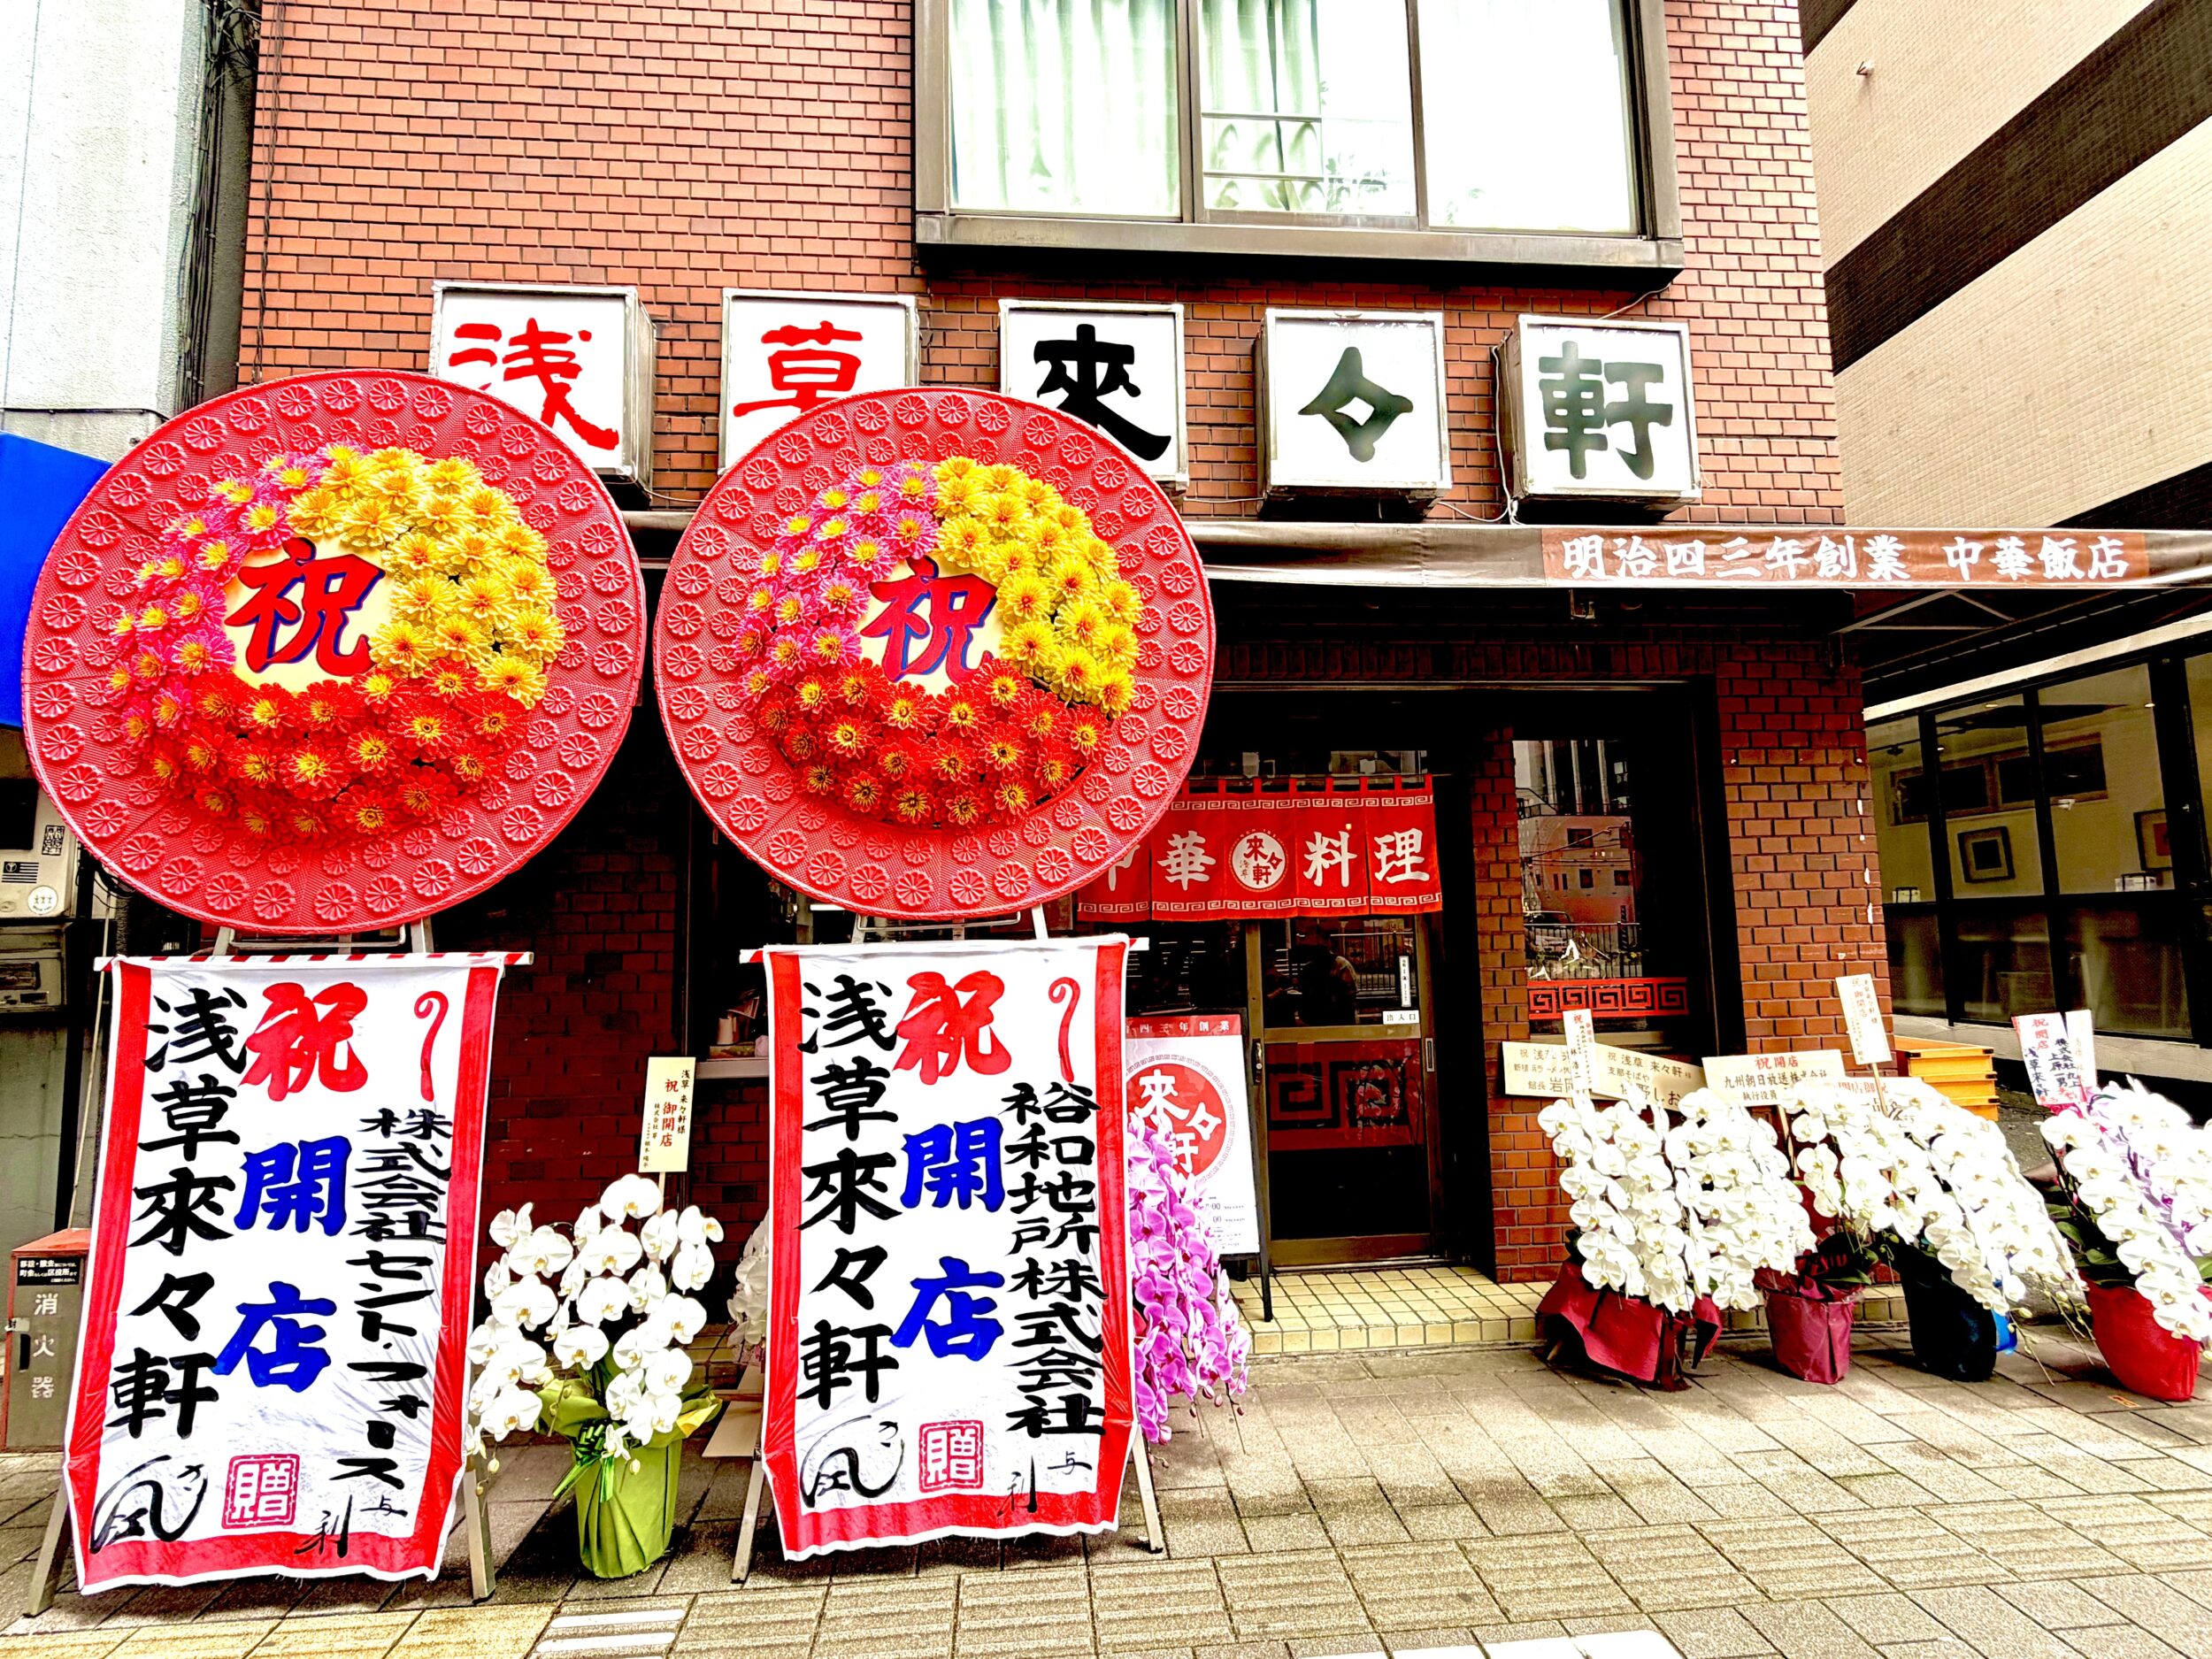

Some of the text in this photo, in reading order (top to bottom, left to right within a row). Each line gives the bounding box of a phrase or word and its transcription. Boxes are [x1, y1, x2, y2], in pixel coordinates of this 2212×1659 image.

[223, 537, 386, 680] 祝
[1563, 534, 2131, 581] 明治四三年創業 中華飯店
[858, 556, 998, 683] 祝
[240, 982, 368, 1101] 祝
[893, 970, 1012, 1084] 祝
[998, 1081, 1108, 1439] 裕和地所株式会社
[31, 1293, 59, 1399] 消火器
[227, 1461, 296, 1523] 贈
[923, 1425, 979, 1486] 贈
